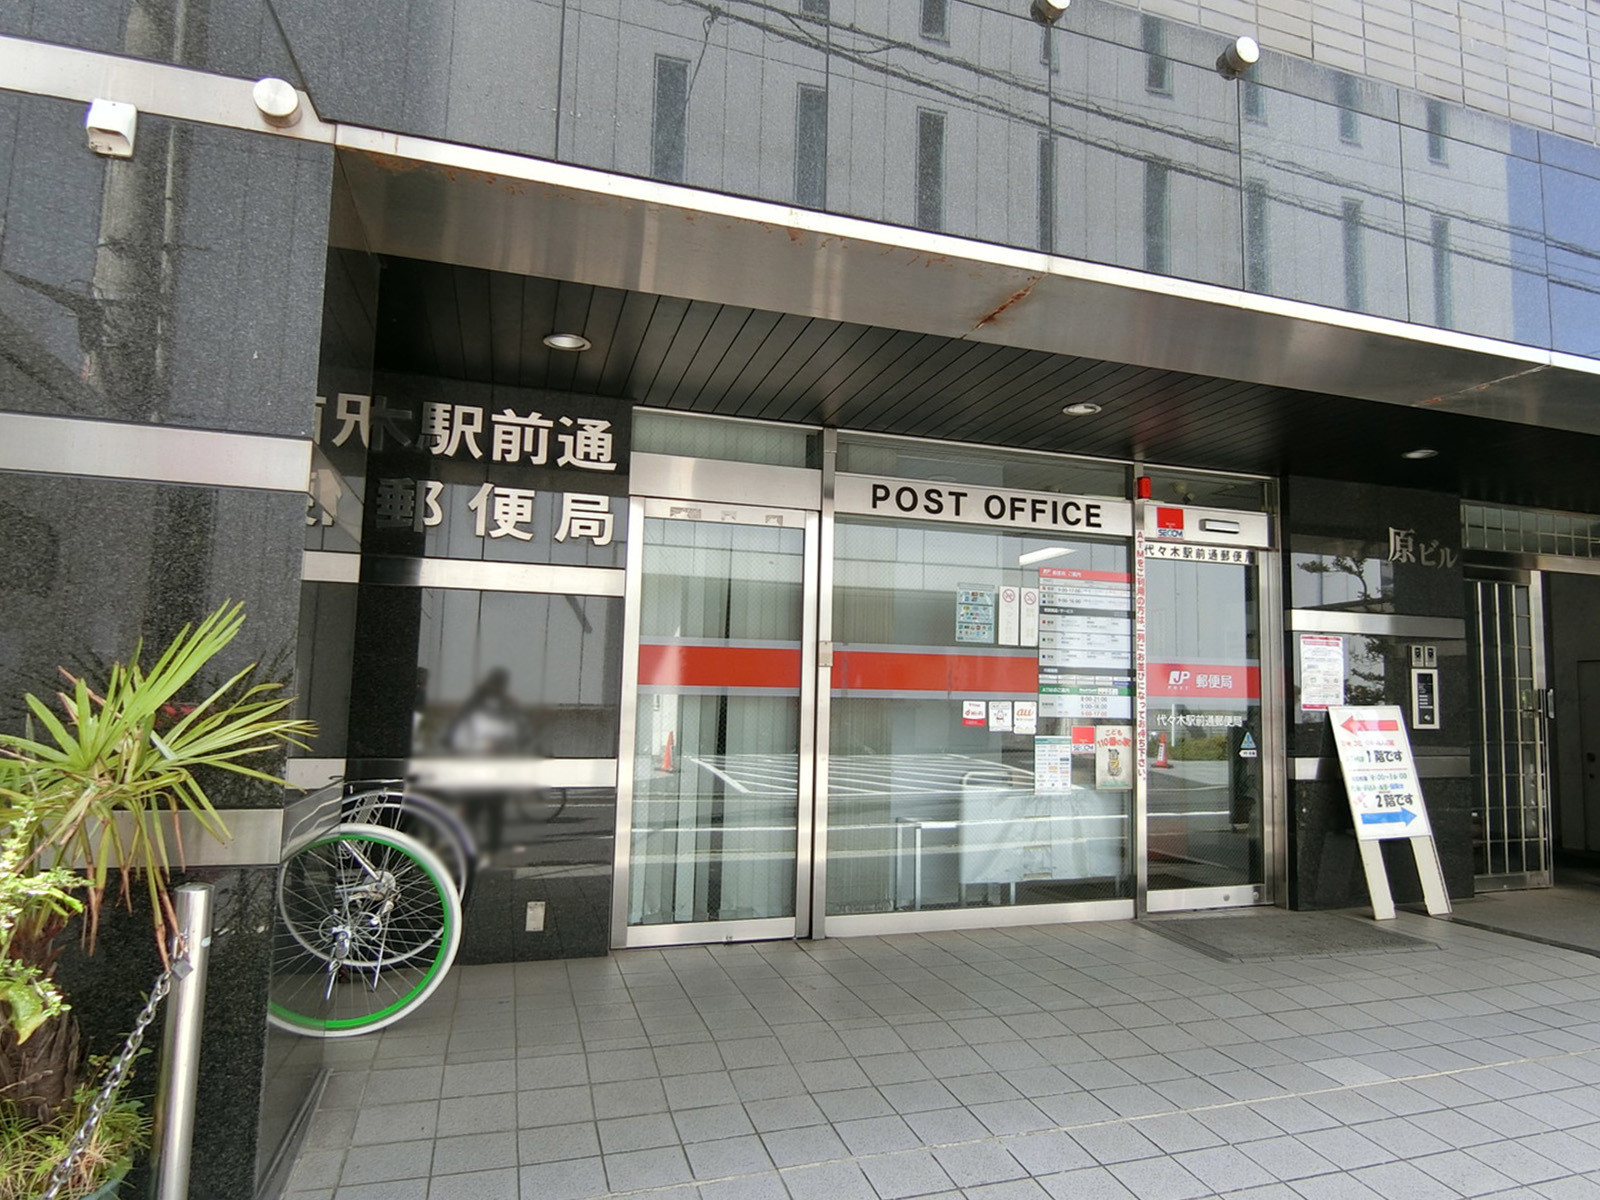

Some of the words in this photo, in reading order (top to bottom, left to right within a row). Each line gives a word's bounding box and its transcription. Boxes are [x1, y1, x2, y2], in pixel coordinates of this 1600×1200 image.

[872, 484, 967, 516] POST
[984, 495, 1102, 528] OFFICE
[1158, 529, 1183, 537] SECOM
[1388, 527, 1458, 568] 原ビル
[1196, 674, 1232, 689] 郵便局
[1016, 708, 1034, 717] au
[1157, 714, 1242, 727] 代々木駅前通郵便局
